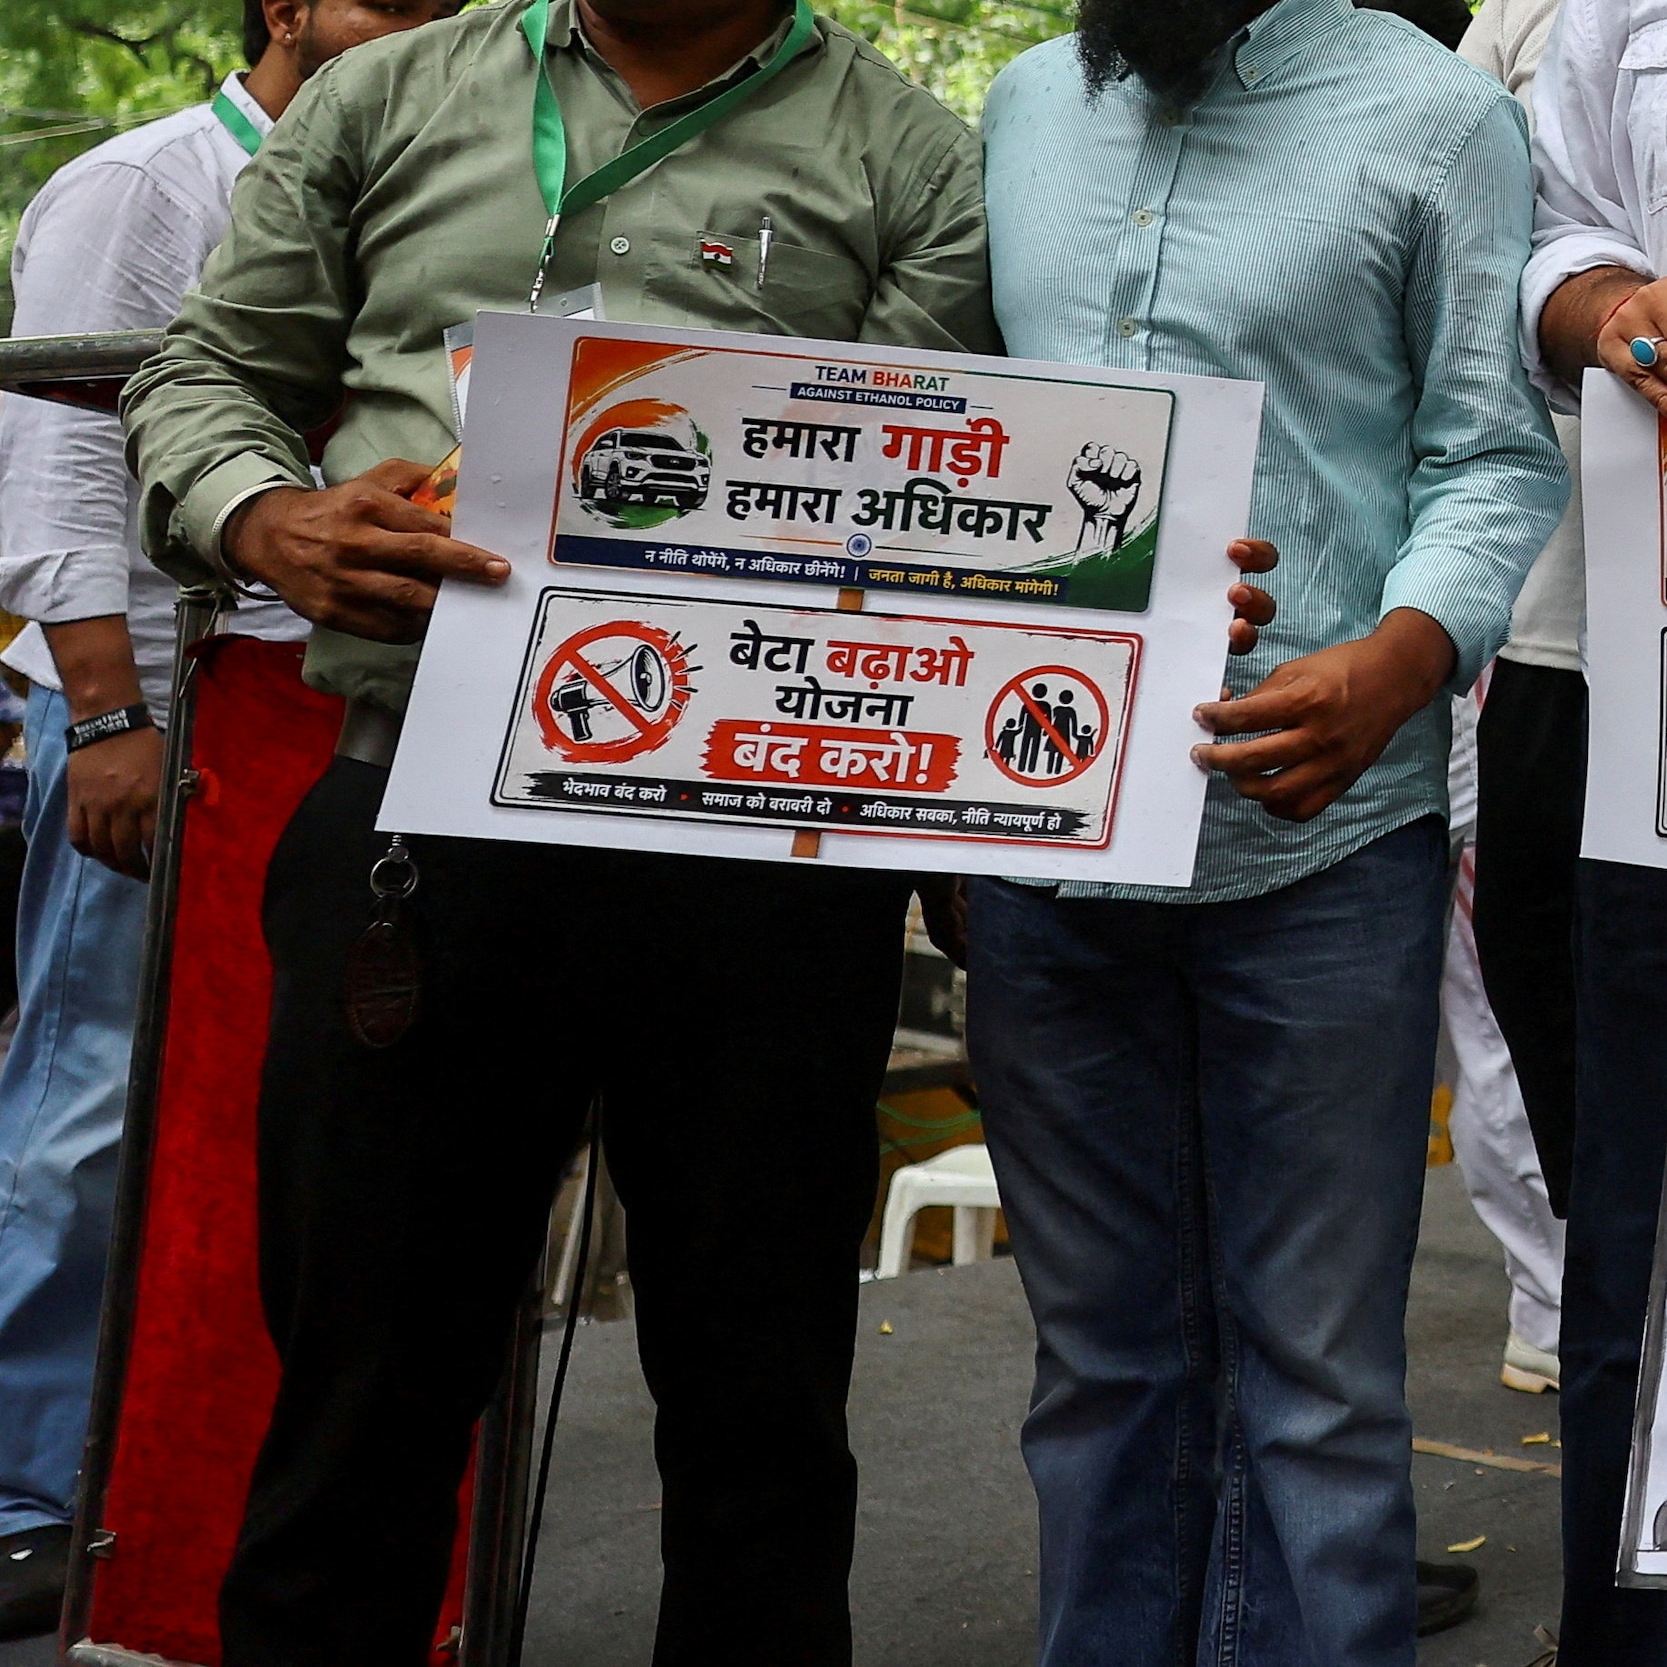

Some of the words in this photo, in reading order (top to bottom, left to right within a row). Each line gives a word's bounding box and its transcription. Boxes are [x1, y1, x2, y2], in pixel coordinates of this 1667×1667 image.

[814, 365, 866, 384] TEAM
[872, 370, 949, 391] BHARAT
[797, 386, 852, 399] AGAINST
[855, 391, 912, 405] ETHANOL
[915, 397, 959, 409] POLICY
[741, 417, 861, 462] हमारा
[883, 418, 1010, 486] गाड़ी
[725, 479, 842, 523] हमारा
[850, 477, 1052, 543] अधिकार
[644, 550, 656, 562] न
[658, 547, 689, 564] नीति
[734, 557, 746, 569] न
[748, 555, 802, 574] अधिकार
[868, 568, 905, 582] जनता
[908, 569, 939, 585] जागी
[960, 573, 1012, 591] अधिकार
[729, 619, 815, 673] बेटा
[827, 636, 973, 685] बढ़ाओ
[775, 675, 914, 726] योजना
[733, 723, 808, 777] बंद
[820, 732, 932, 783] करो!
[562, 776, 611, 797] भेदभाव
[638, 784, 667, 801] करो
[701, 792, 743, 807] समाज
[746, 792, 766, 809] को
[816, 797, 832, 814] दो
